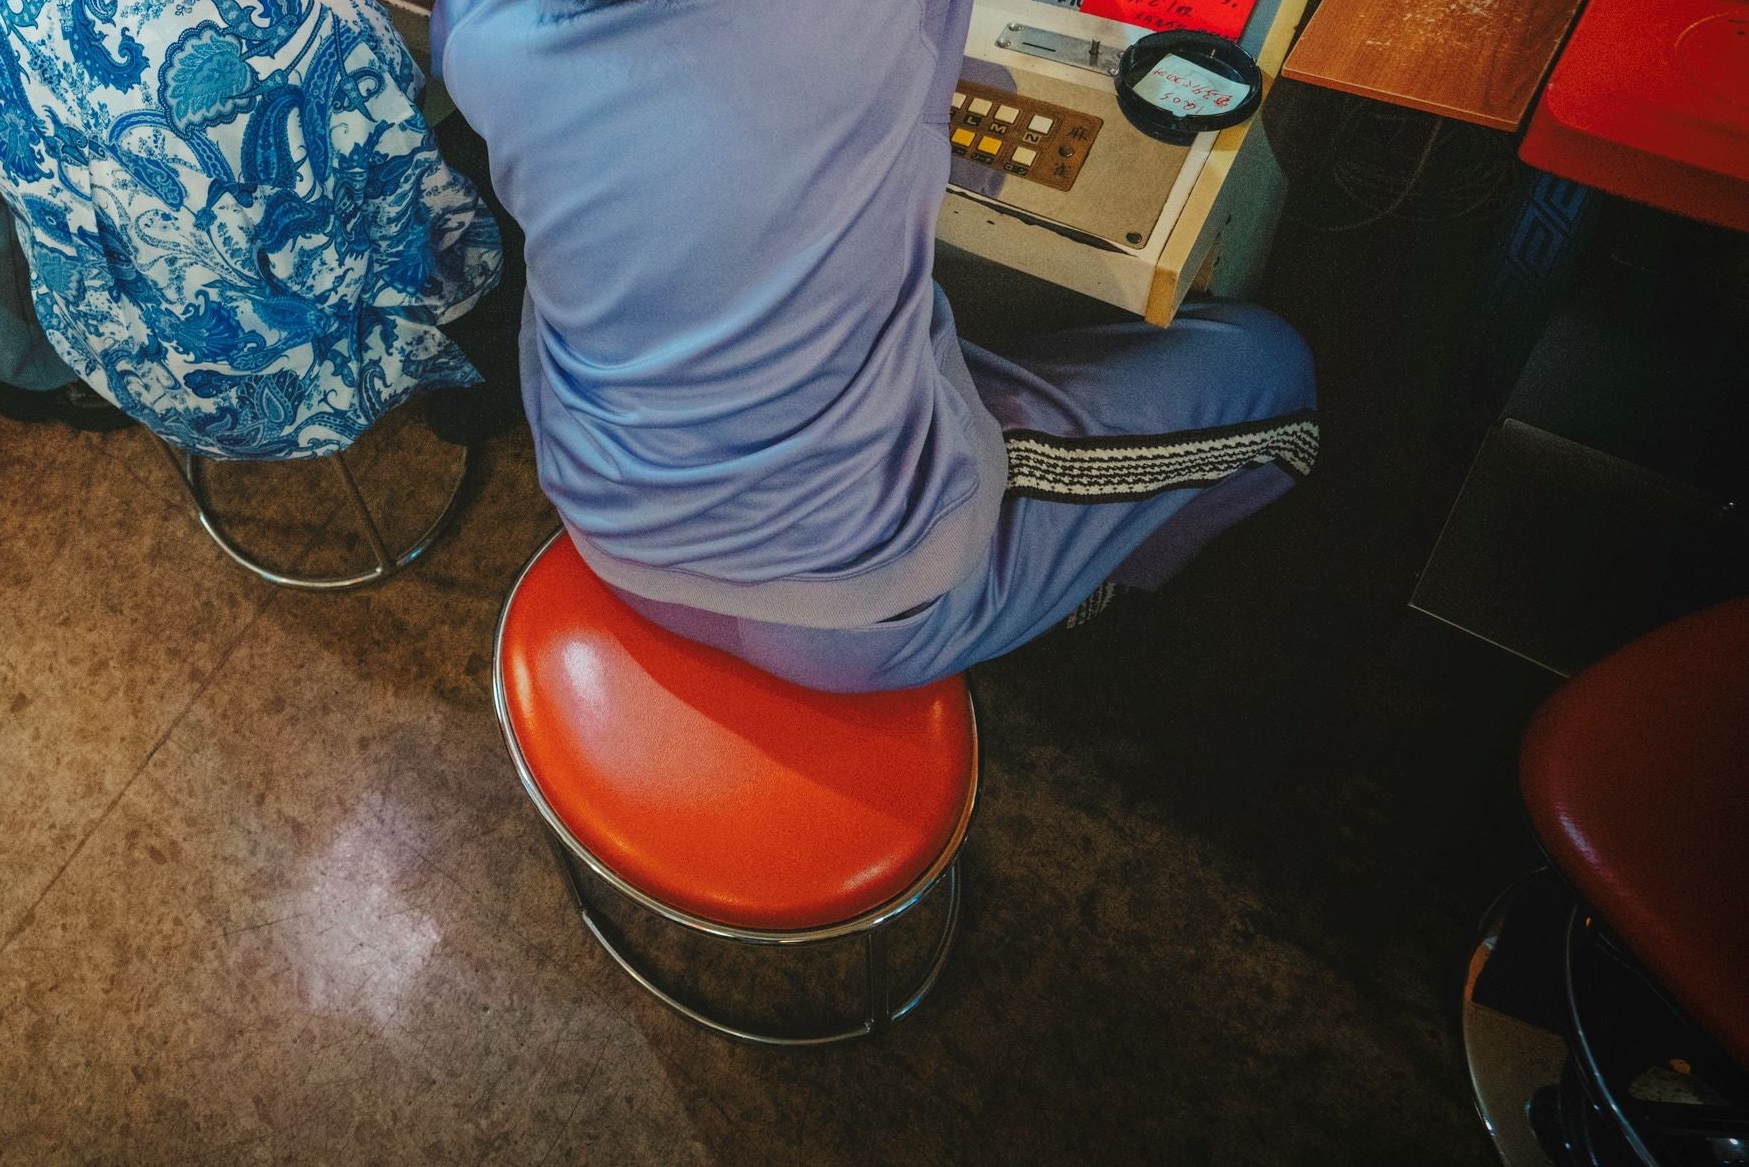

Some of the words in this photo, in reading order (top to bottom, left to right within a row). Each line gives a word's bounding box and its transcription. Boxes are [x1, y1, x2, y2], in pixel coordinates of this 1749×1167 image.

[989, 123, 1007, 134] M
[1024, 134, 1040, 143] N
[1067, 125, 1089, 141] 麻
[1053, 161, 1071, 177] 雀
